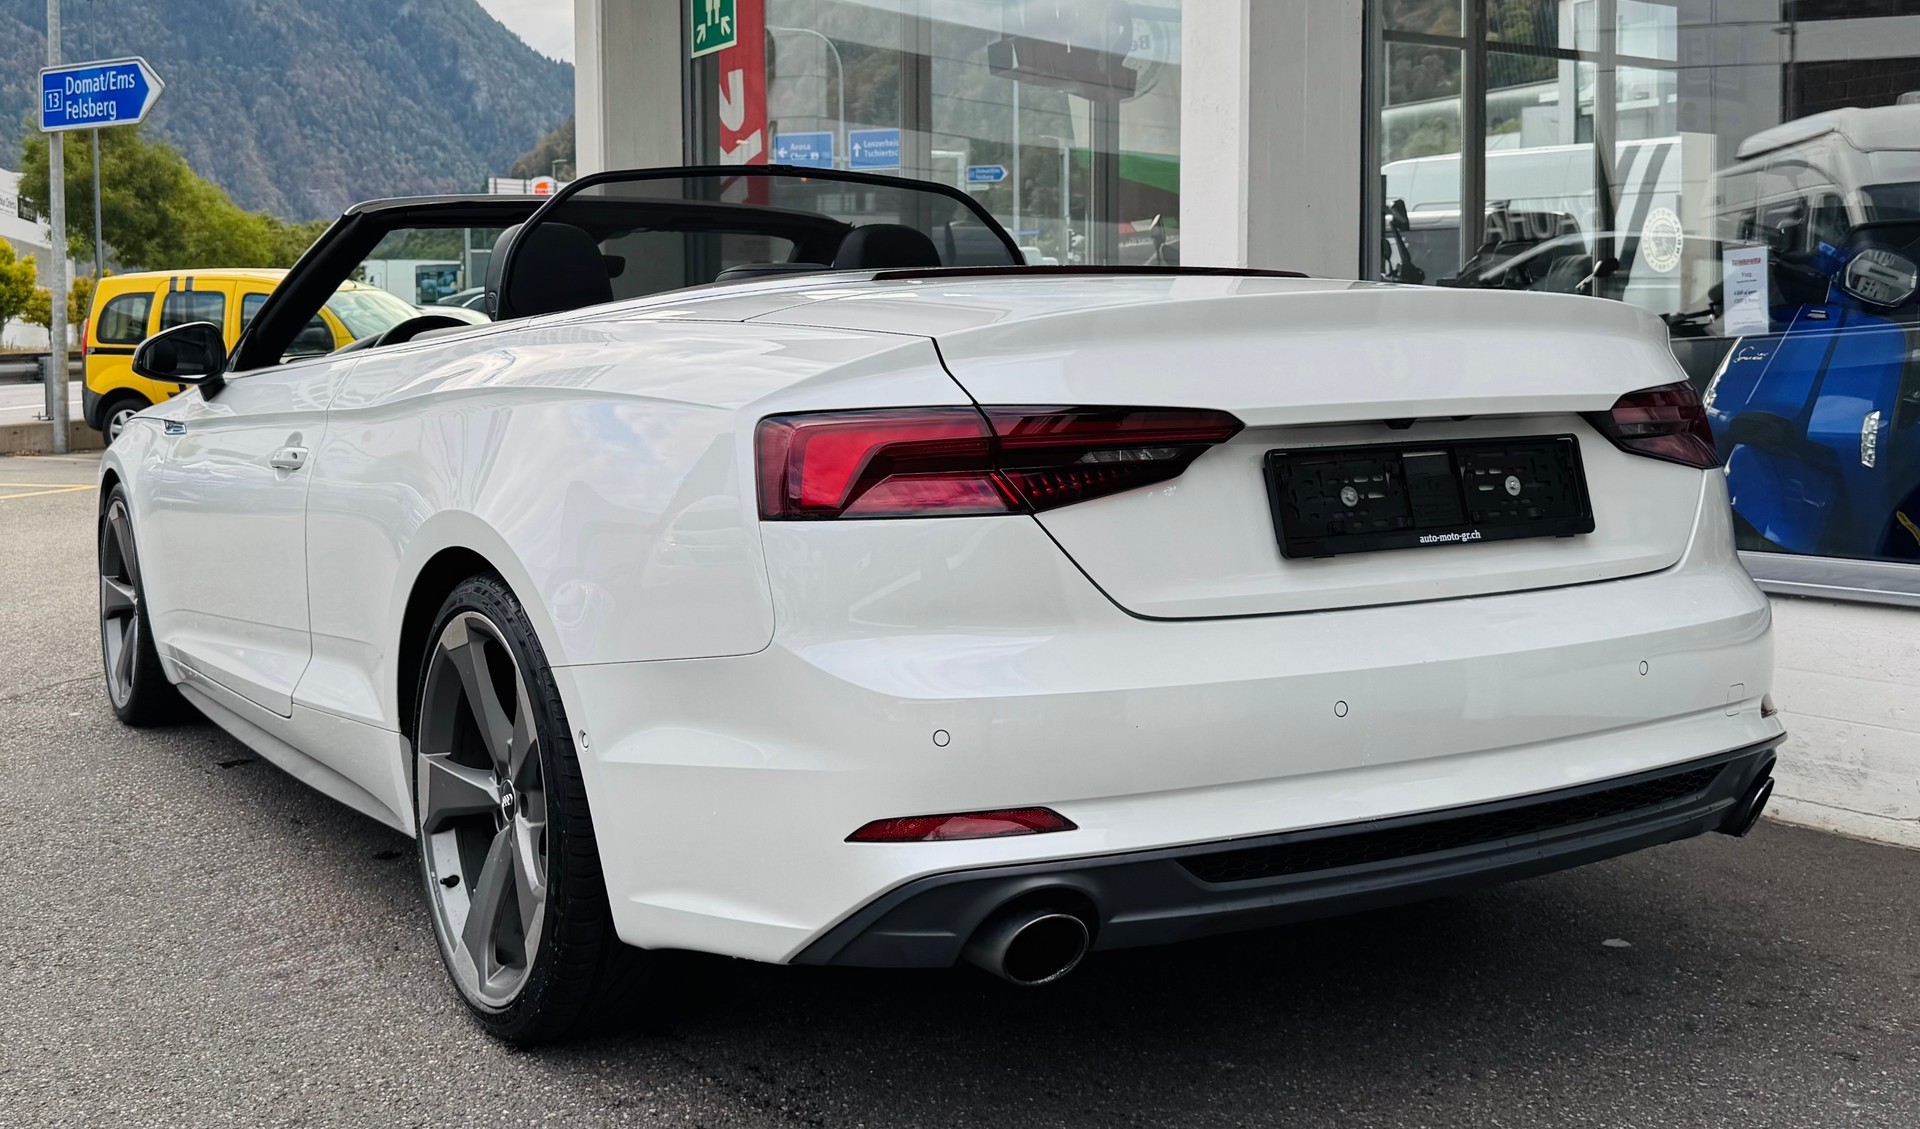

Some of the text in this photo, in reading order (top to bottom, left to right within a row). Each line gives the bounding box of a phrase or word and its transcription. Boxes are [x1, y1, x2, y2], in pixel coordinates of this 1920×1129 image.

[65, 70, 136, 96] Domat/Ems
[47, 92, 60, 109] 13
[65, 97, 117, 120] Felsberg
[790, 142, 811, 151] Arosa
[1419, 529, 1481, 543] auto-moto-gr.ch
